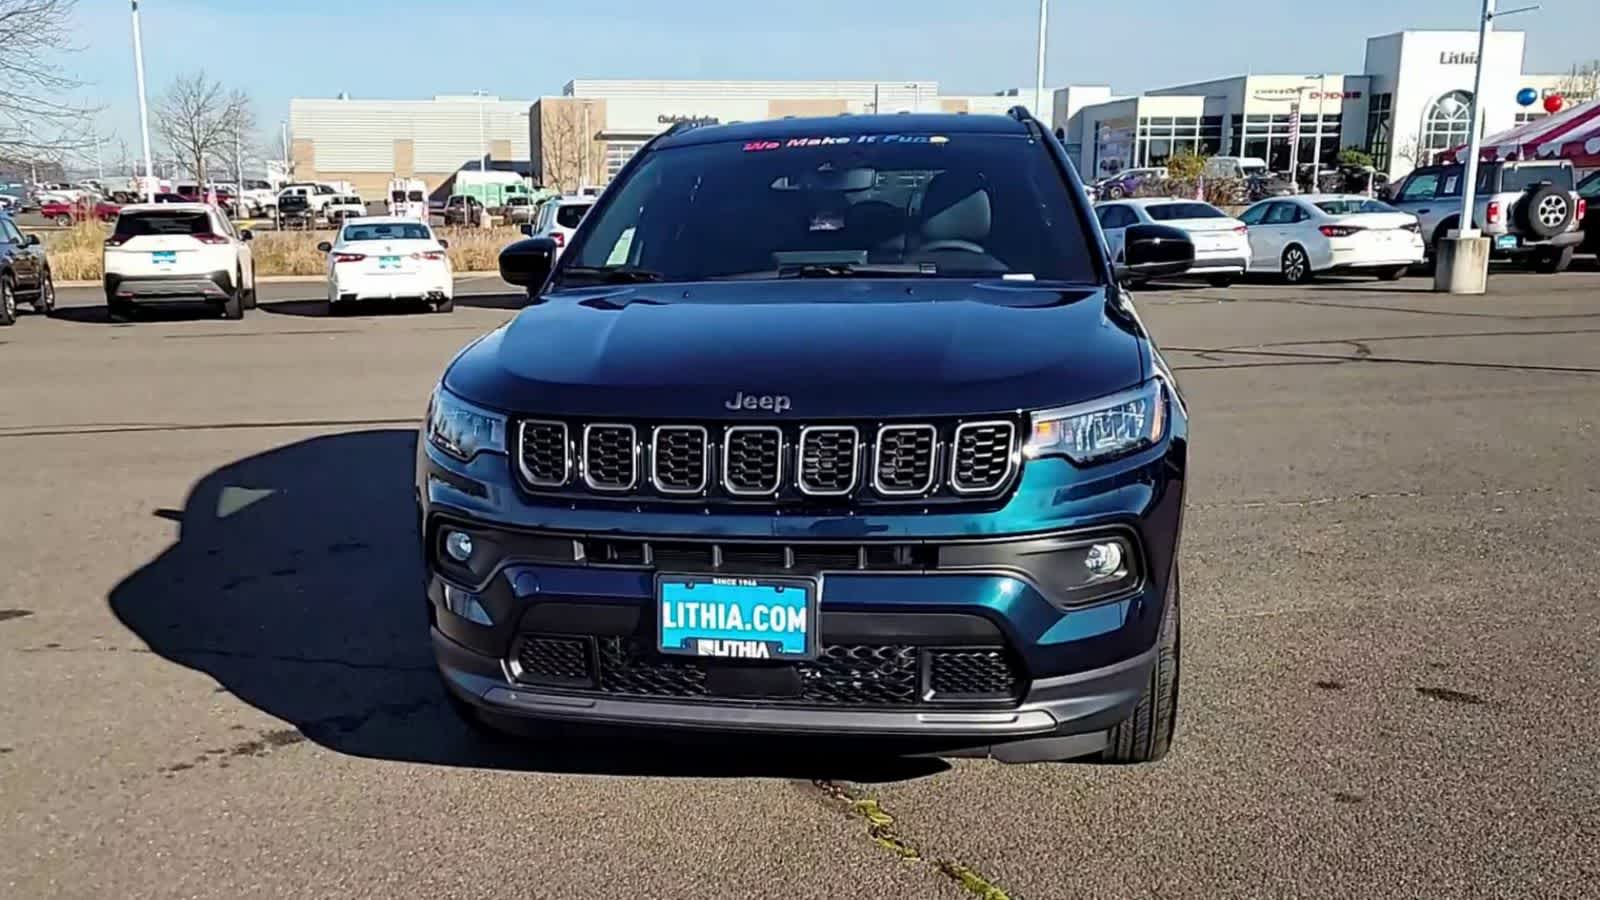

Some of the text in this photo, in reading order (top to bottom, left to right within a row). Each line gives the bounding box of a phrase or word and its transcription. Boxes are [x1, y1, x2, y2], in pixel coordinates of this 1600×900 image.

[742, 141, 780, 152] We
[786, 136, 850, 147] Make
[725, 391, 792, 414] Jeep
[712, 577, 737, 586] SINCE
[662, 601, 807, 633] LITHIA.COM
[714, 639, 771, 659] LITHIA
